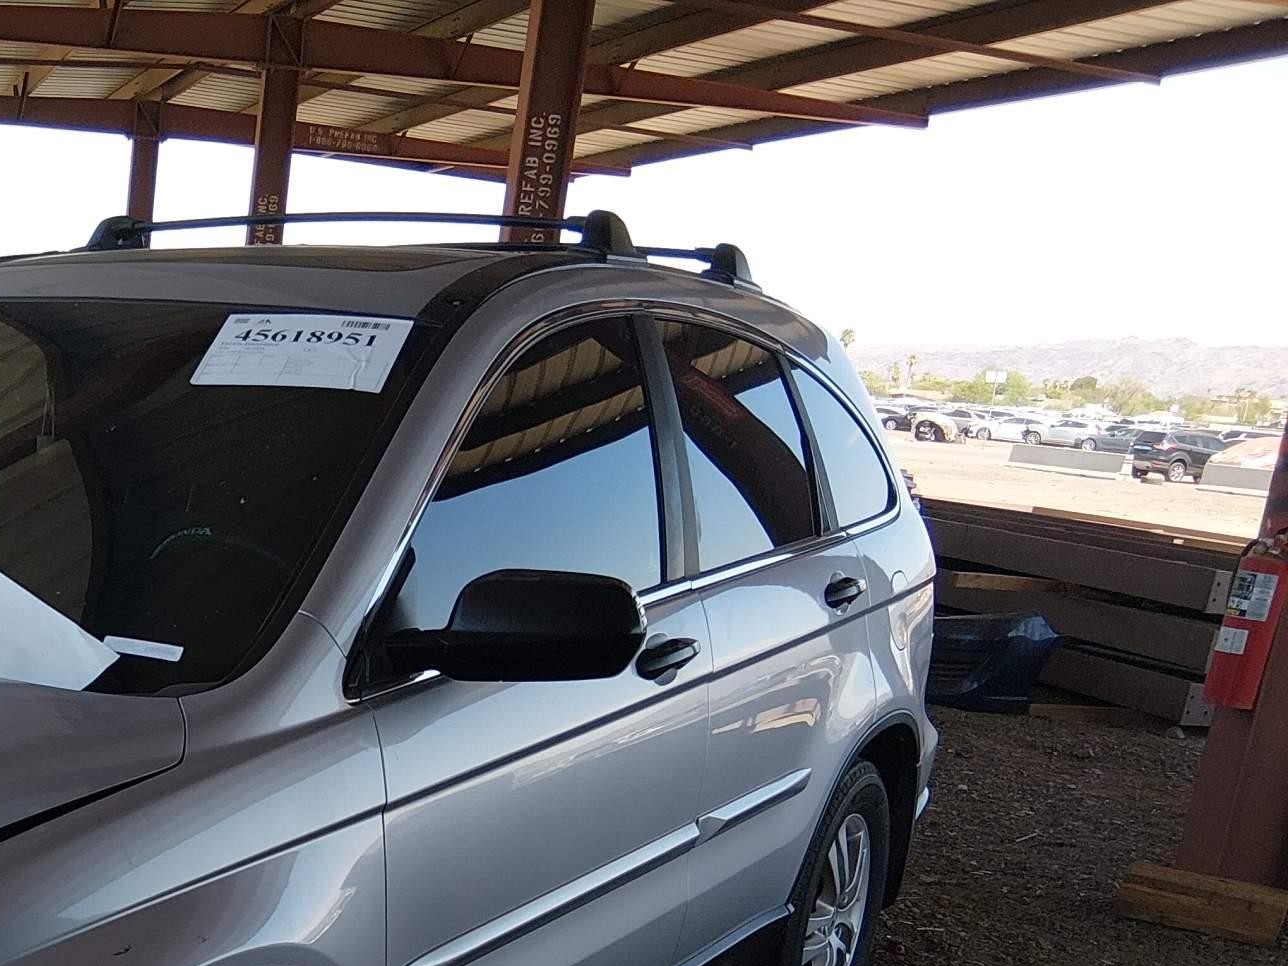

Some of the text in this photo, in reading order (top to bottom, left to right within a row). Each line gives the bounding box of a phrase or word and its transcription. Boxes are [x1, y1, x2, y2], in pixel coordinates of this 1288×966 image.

[518, 112, 546, 216] REFAB INC.
[234, 329, 377, 347] 45618951
